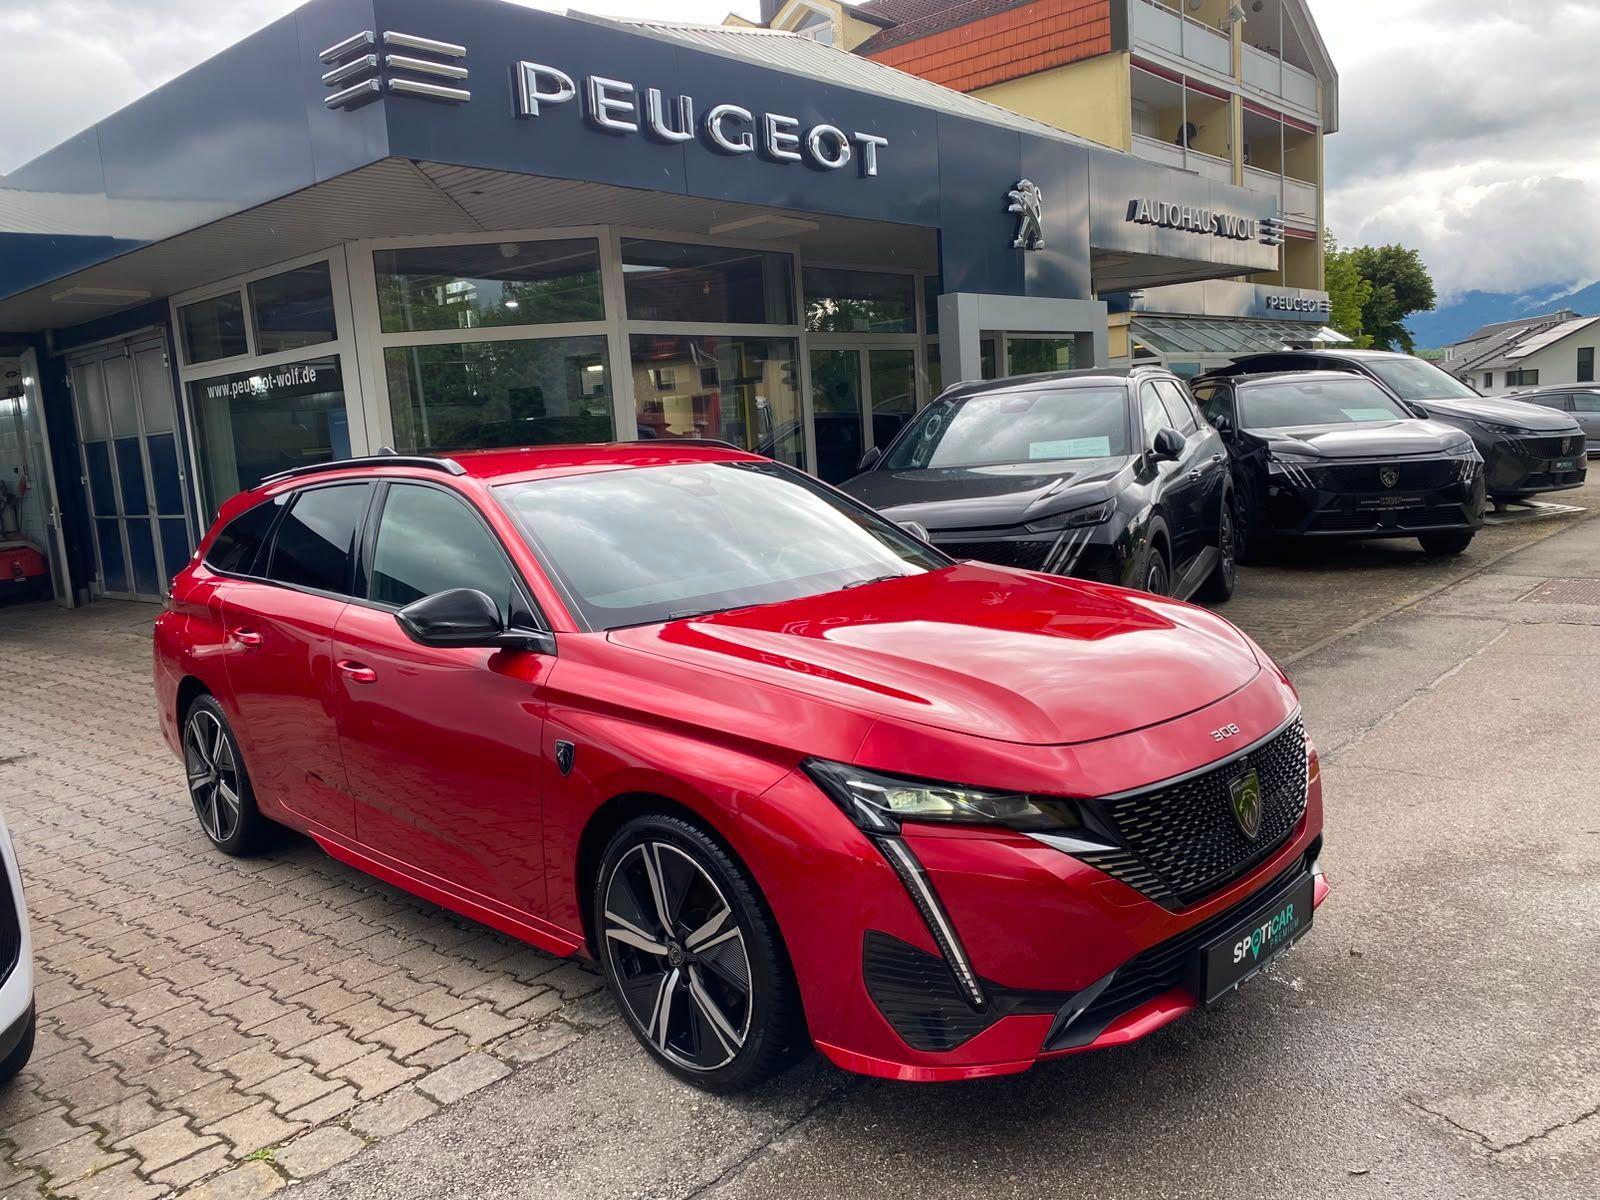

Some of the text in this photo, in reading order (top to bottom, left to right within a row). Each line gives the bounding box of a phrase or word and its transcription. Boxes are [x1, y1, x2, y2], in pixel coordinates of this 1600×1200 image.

[513, 60, 889, 177] PEUGEOT
[1136, 198, 1259, 240] AUTOHAUS WOLF
[1271, 295, 1320, 312] PEUGEOT
[1210, 723, 1240, 742] 308
